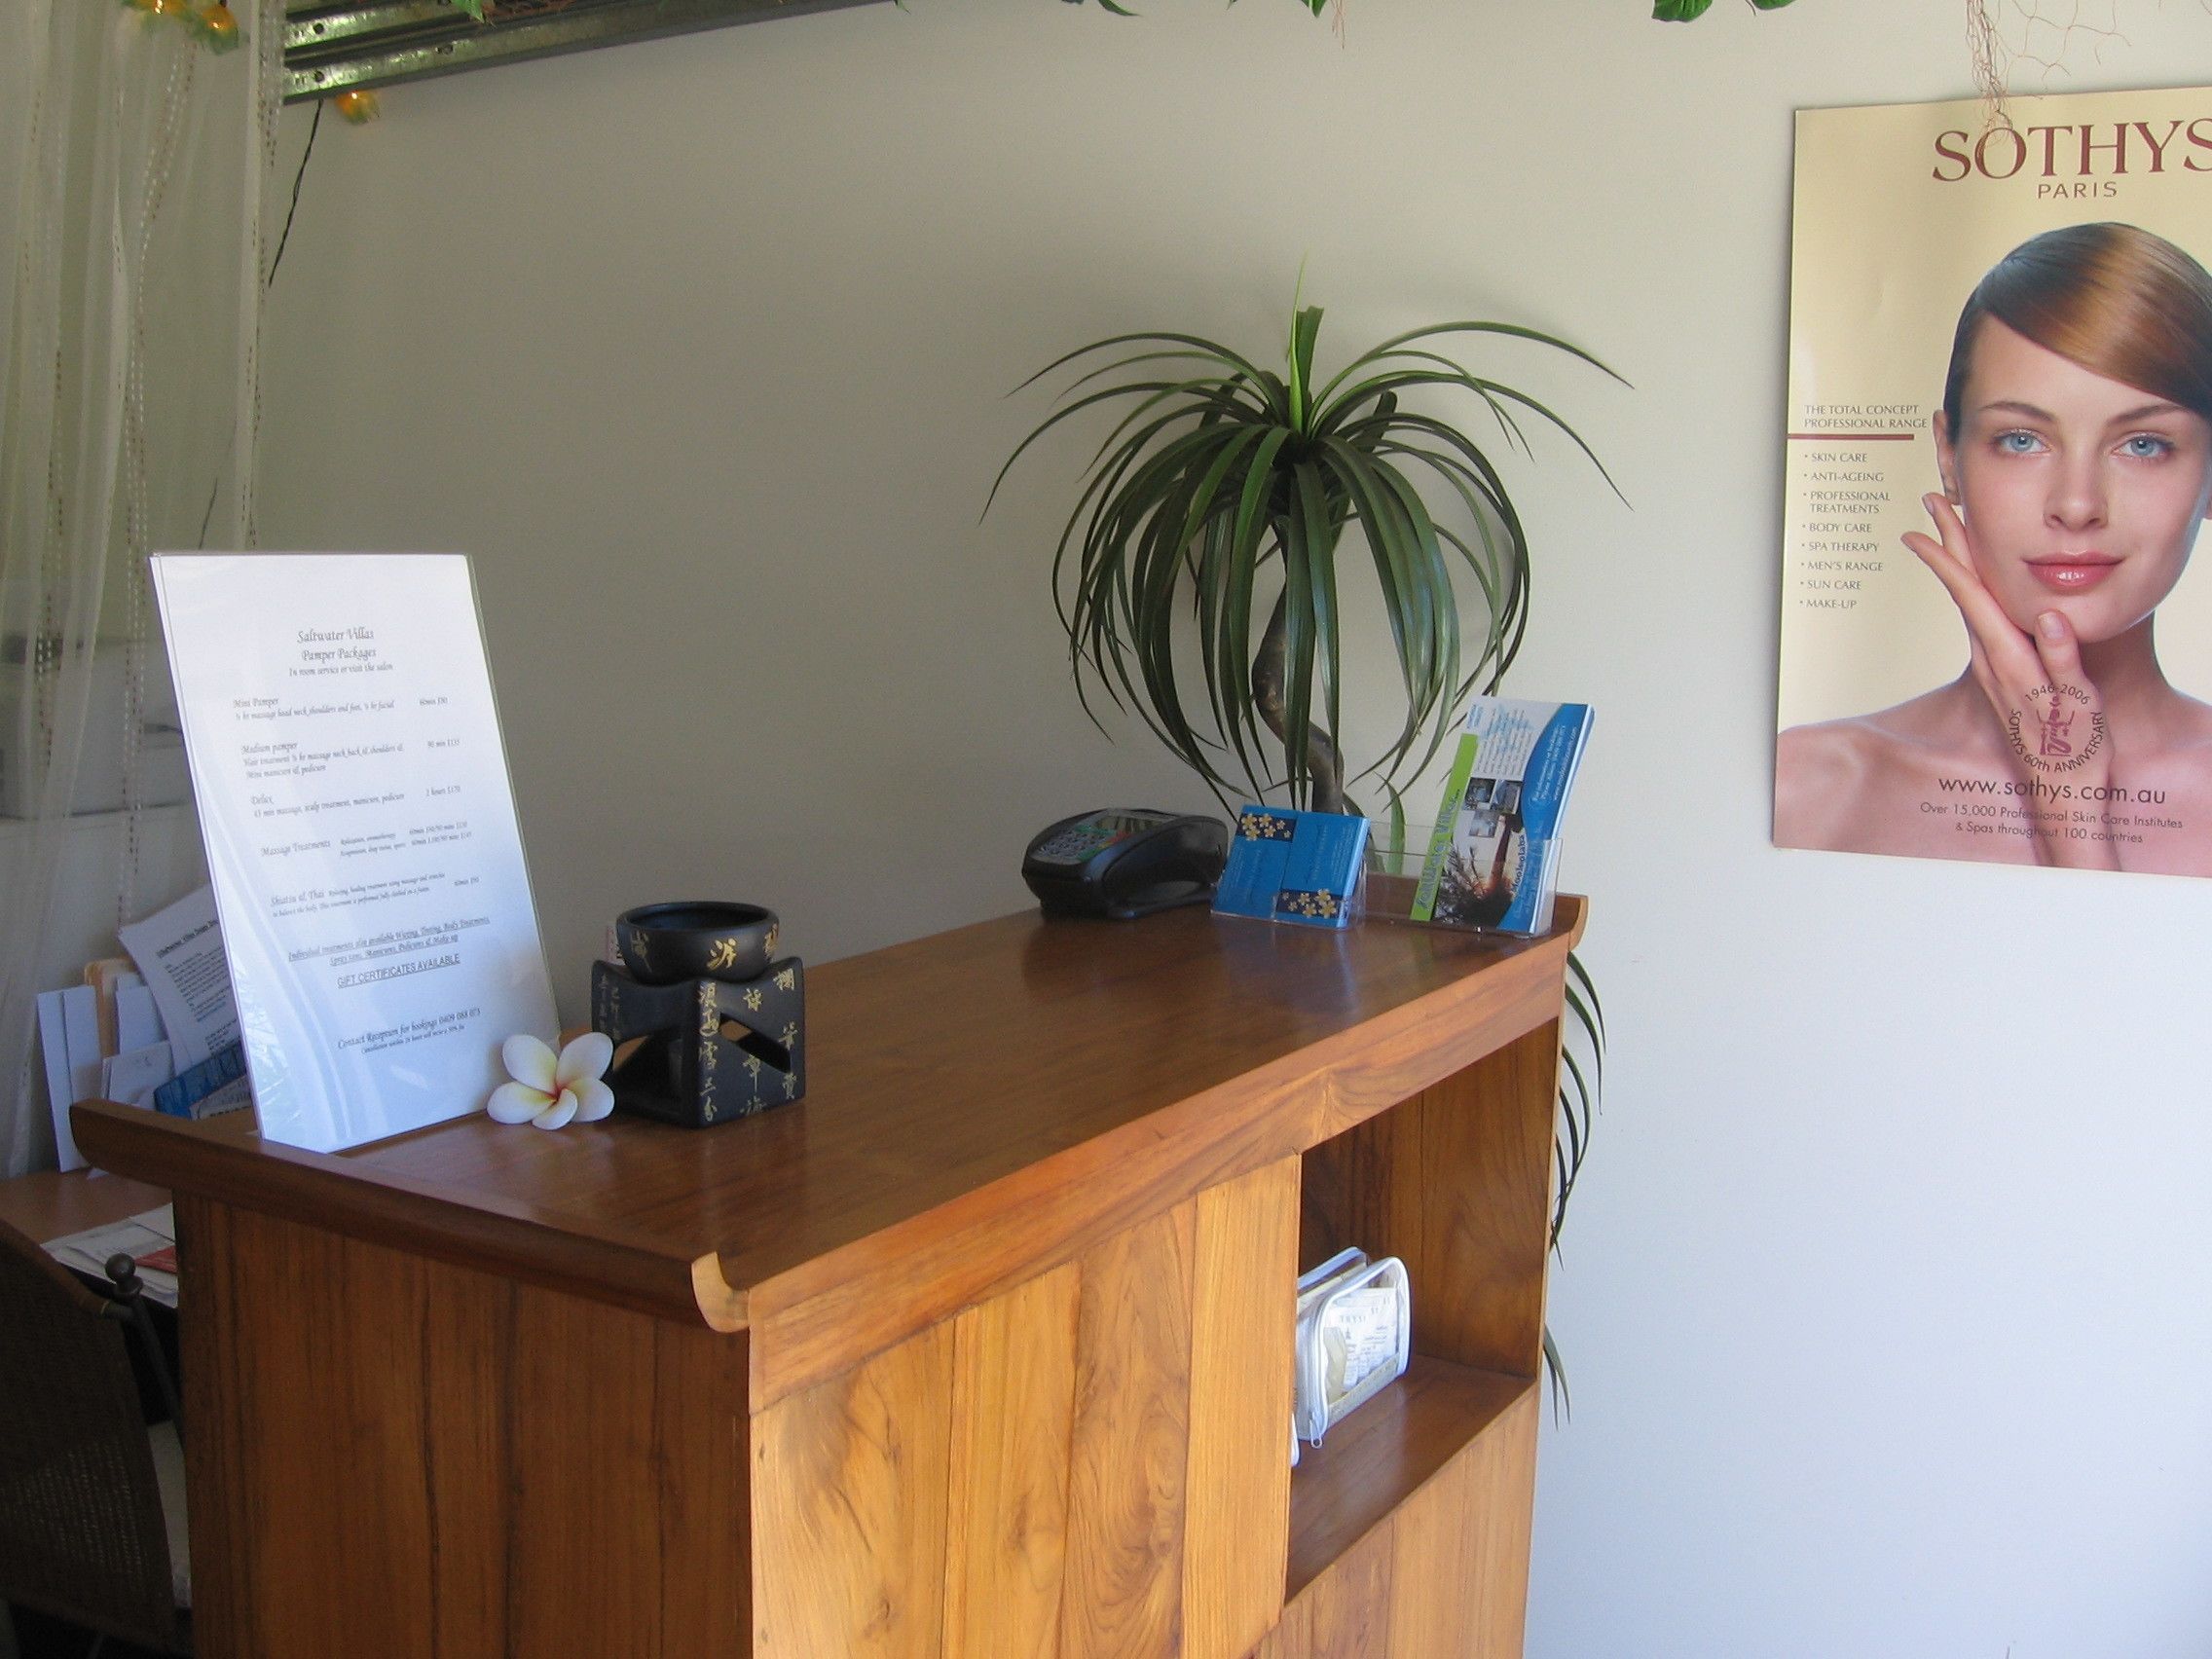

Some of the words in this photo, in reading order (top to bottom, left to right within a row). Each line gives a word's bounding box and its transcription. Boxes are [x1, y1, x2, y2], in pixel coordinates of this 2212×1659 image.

[1932, 118, 2212, 182] SOTHYS
[2038, 181, 2118, 200] PARIS
[1804, 405, 1826, 415] THE
[1829, 405, 1862, 415] TOTAL
[1866, 404, 1919, 415] CONCEPT
[1804, 418, 1885, 428] PROFESSIONAL
[1889, 419, 1928, 428] RANGE
[1811, 453, 1836, 462] SKIN
[1839, 453, 1867, 462] CARE
[1811, 472, 1885, 482] ANTI-AGEING
[1810, 491, 1891, 501] PROFESSIONAL
[1810, 503, 1880, 514] TREATMENTS
[1809, 523, 1839, 533] BODY
[1844, 523, 1872, 534] CARE
[1809, 542, 1827, 552] SPA
[1831, 542, 1879, 552] THERAPY
[1807, 561, 1842, 571] MEN'S
[1845, 562, 1884, 571] RANGE
[1807, 580, 1830, 590] SUN
[1834, 580, 1862, 590] CARE
[1806, 599, 1857, 609] MAKE-UP
[297, 629, 344, 644] Saltwater
[347, 626, 375, 640] Villas
[302, 649, 335, 664] Pamper
[337, 645, 377, 661] Packages
[2009, 709, 2027, 756] SOTHYS
[2024, 755, 2050, 773] 60th
[2054, 712, 2104, 773] ANNIVERSARY
[1938, 775, 2166, 805] www.sothys.com.au
[1920, 802, 1948, 815] Over
[1954, 804, 1996, 819] 15,000
[2072, 810, 2096, 824] Skin
[2100, 813, 2130, 827] Care
[2133, 814, 2183, 829] Institutes
[1966, 821, 1993, 836] Spas
[1998, 823, 2058, 839] throughout
[2064, 828, 2087, 840] 100
[2090, 830, 2144, 844] countries
[337, 975, 355, 988] GIFT
[358, 962, 417, 983] CERTIFICATES
[418, 953, 461, 973] AVAILABLE
